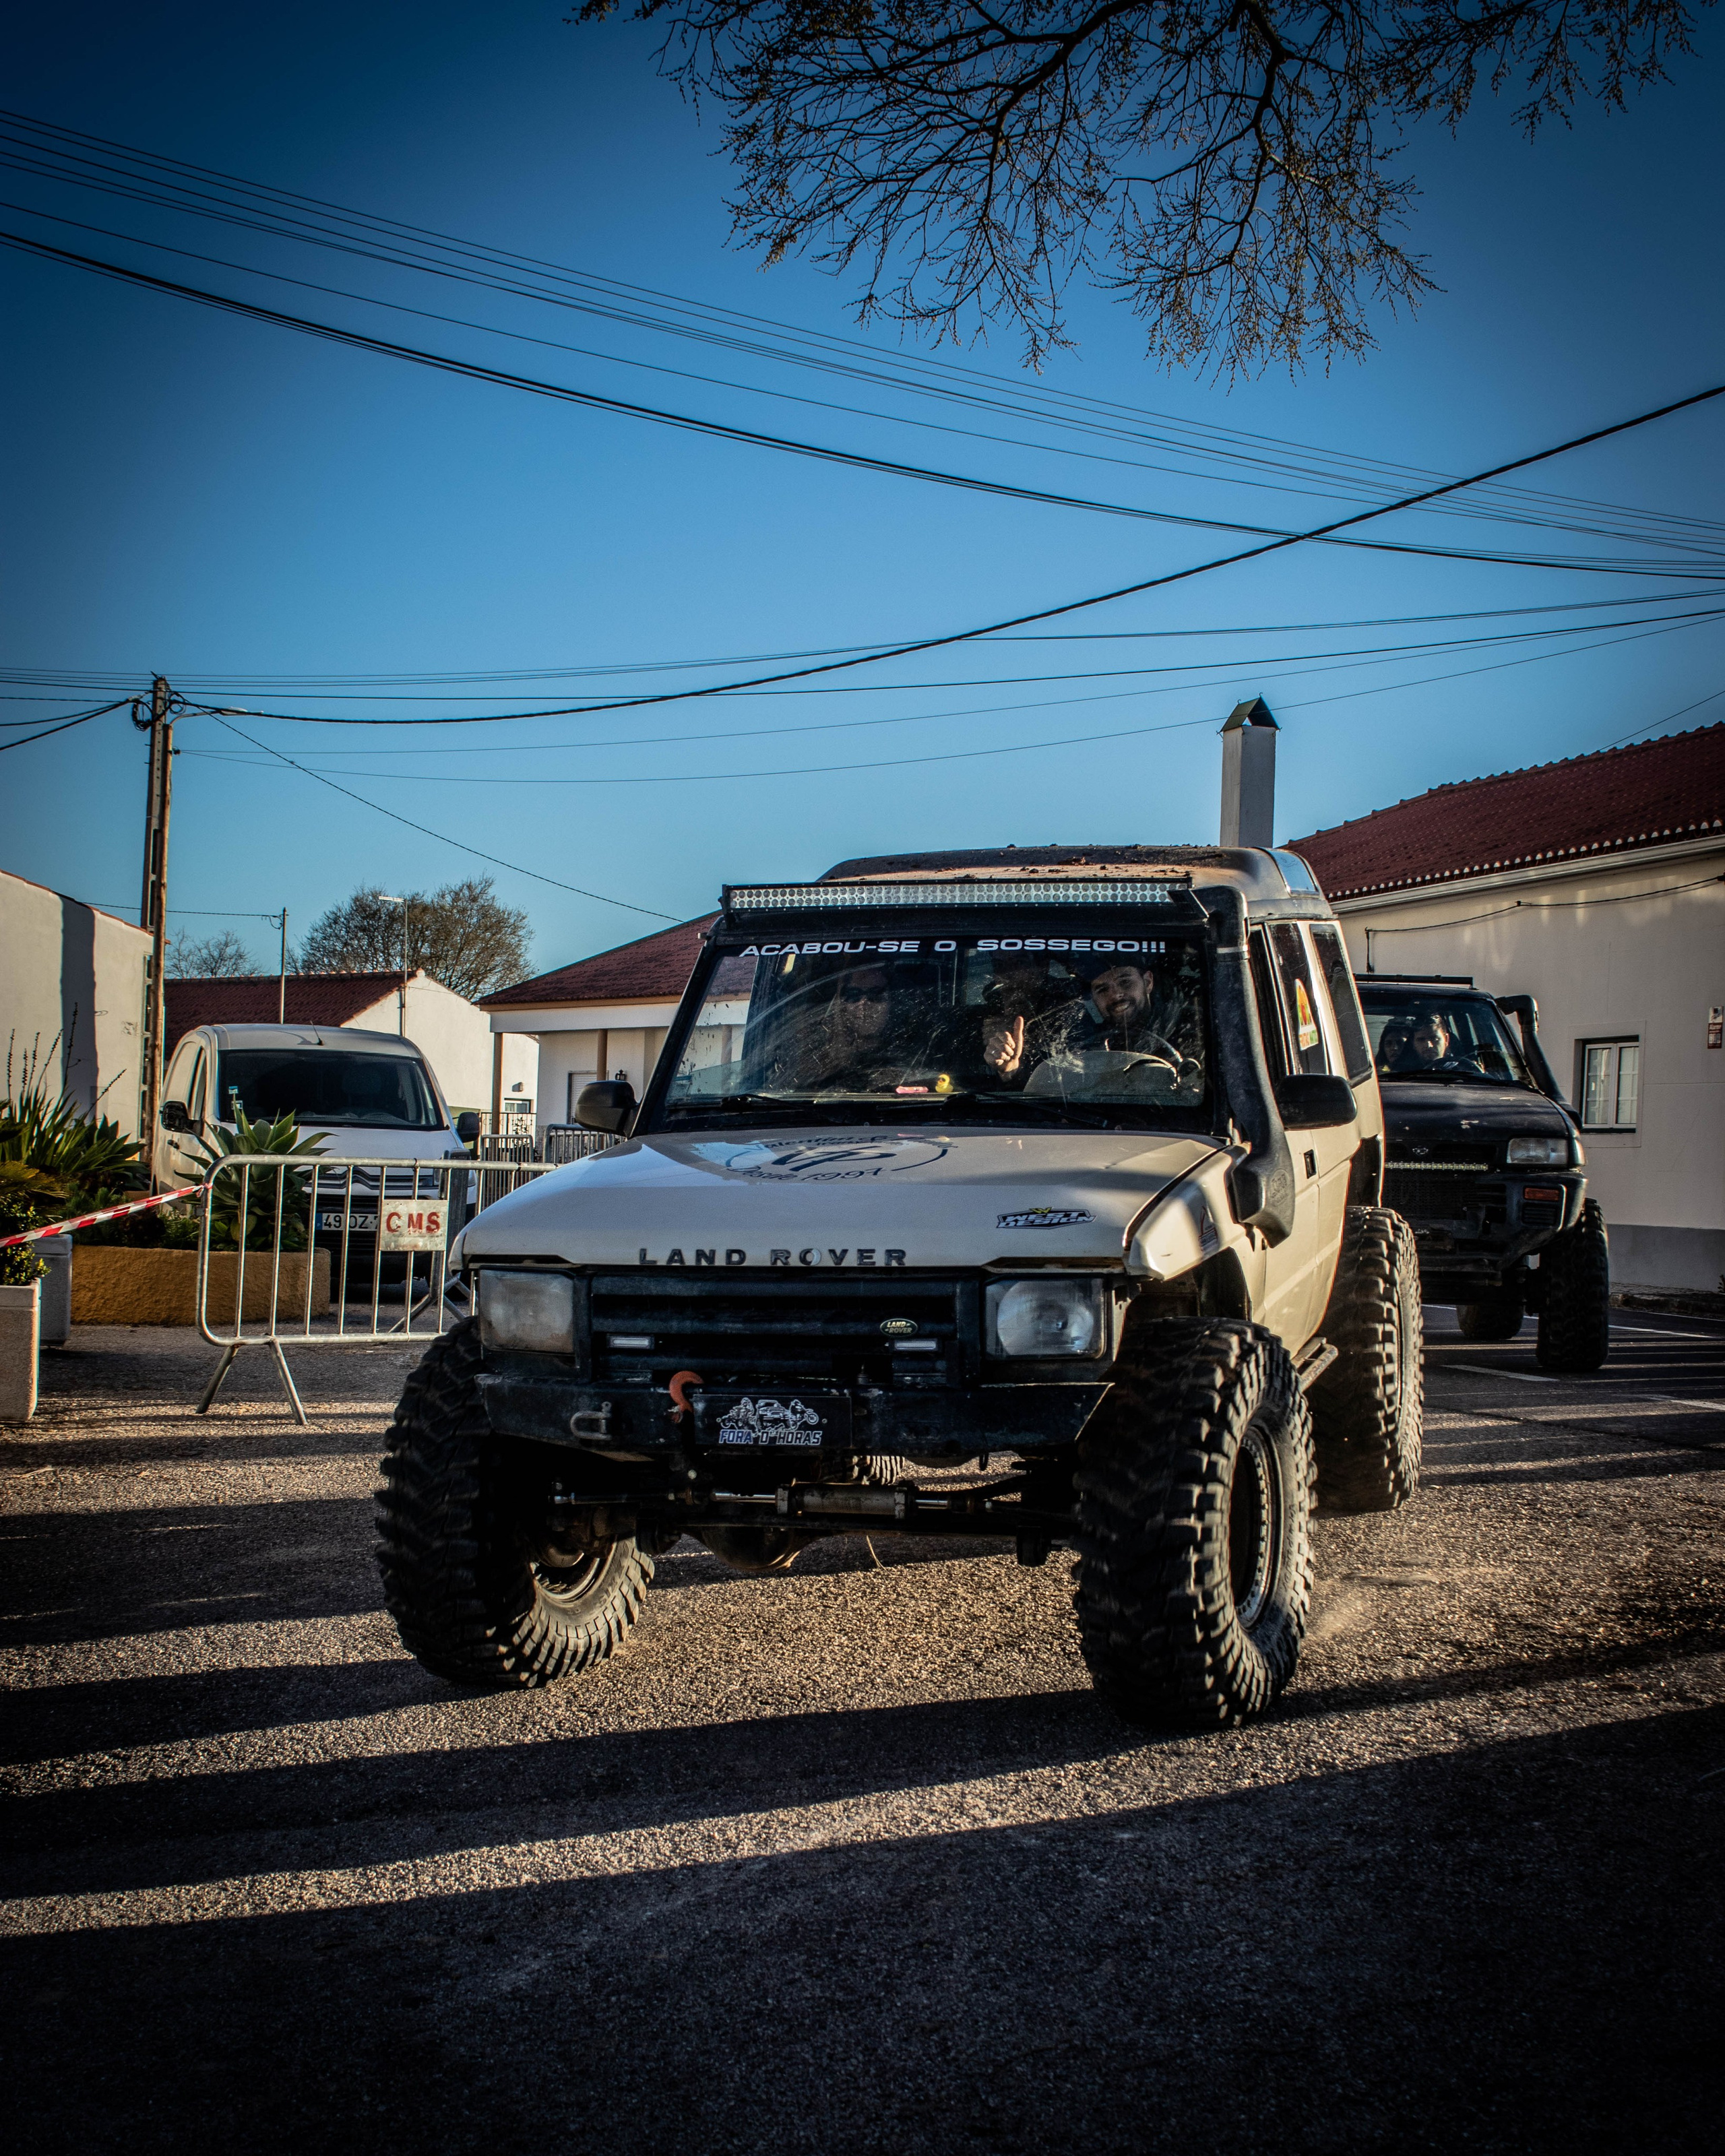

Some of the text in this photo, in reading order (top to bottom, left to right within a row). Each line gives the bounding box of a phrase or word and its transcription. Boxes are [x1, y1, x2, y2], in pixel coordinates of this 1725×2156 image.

[739, 939, 1166, 957] ACABOU-SE O SOSSEGO!!!
[801, 1167, 883, 1180] 1997
[386, 1212, 440, 1233] CMS
[997, 1215, 1096, 1228] DESIGN
[1005, 1212, 1079, 1222] WEST
[638, 1248, 906, 1265] LAND ROVER
[718, 1429, 753, 1444] FORA
[776, 1430, 823, 1445] HORAS
